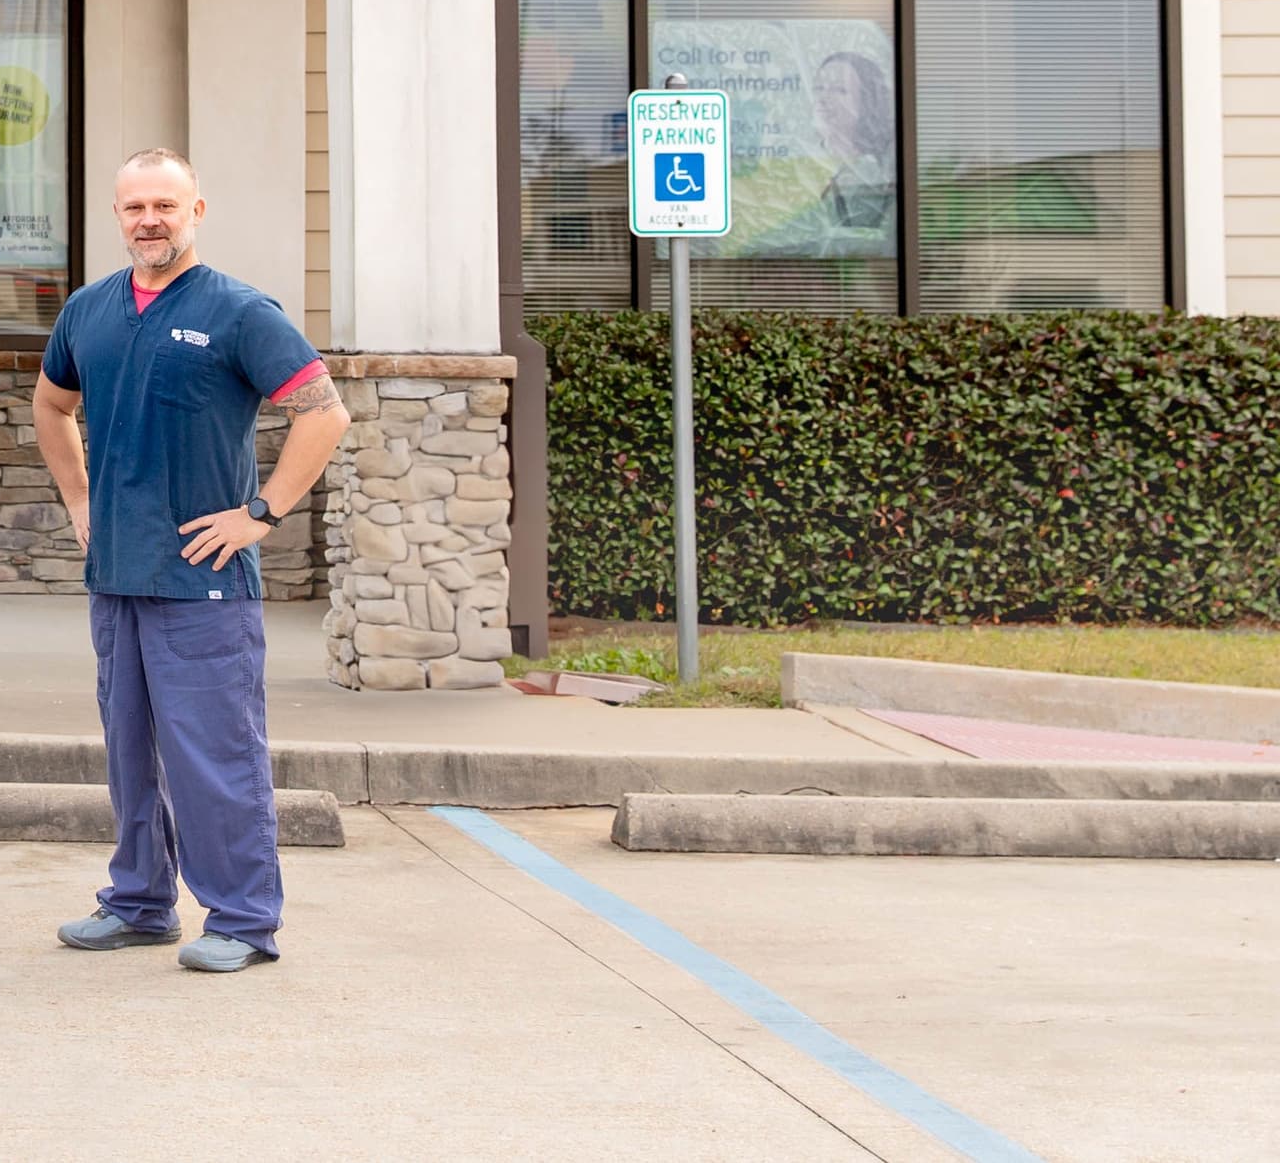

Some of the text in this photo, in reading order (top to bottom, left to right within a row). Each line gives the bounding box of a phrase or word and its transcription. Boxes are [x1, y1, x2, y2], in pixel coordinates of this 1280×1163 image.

[658, 46, 771, 66] Call for an
[636, 102, 722, 121] RESERVED
[642, 127, 716, 145] PARKING
[669, 203, 689, 213] VAN
[649, 214, 709, 225] ACCESSIBLE
